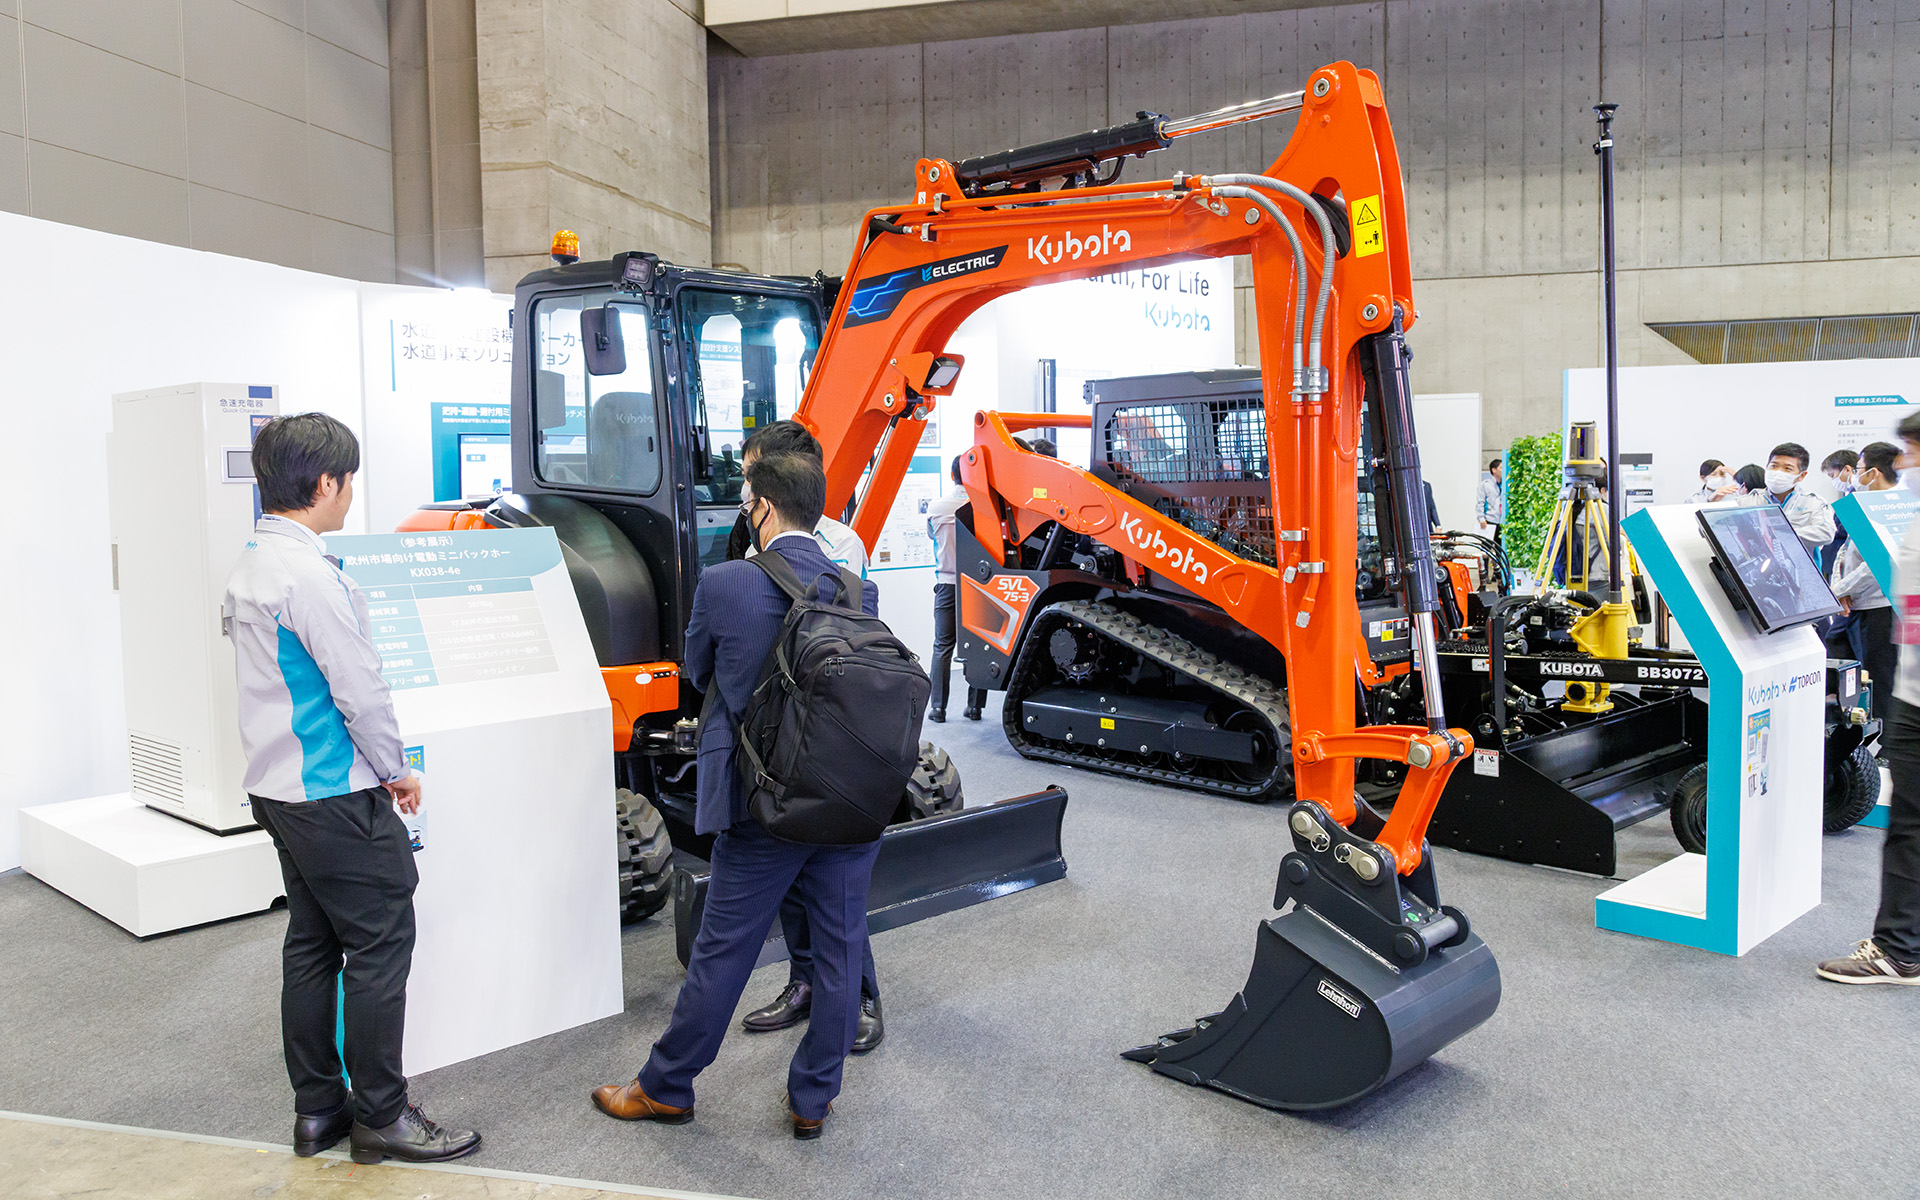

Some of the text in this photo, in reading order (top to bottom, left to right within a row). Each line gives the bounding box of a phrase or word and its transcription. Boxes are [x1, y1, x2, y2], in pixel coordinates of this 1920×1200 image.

[1028, 224, 1131, 265] Kubota
[932, 254, 995, 278] ELECTRIC
[1179, 270, 1210, 297] Life
[1144, 301, 1210, 332] Kubota
[219, 398, 264, 408] 急速充電器
[616, 413, 654, 424] Kubota
[1119, 511, 1208, 585] Kubota
[410, 567, 461, 578] KX038-4e
[370, 584, 483, 599] 項目 内容
[997, 578, 1027, 592] SVL
[380, 624, 397, 633] 出力
[1539, 661, 1704, 681] KUBOTA BB3072
[1748, 680, 1780, 706] Kubota
[1797, 670, 1822, 689] TOPCON
[1319, 983, 1358, 1015] Lehnhoff
